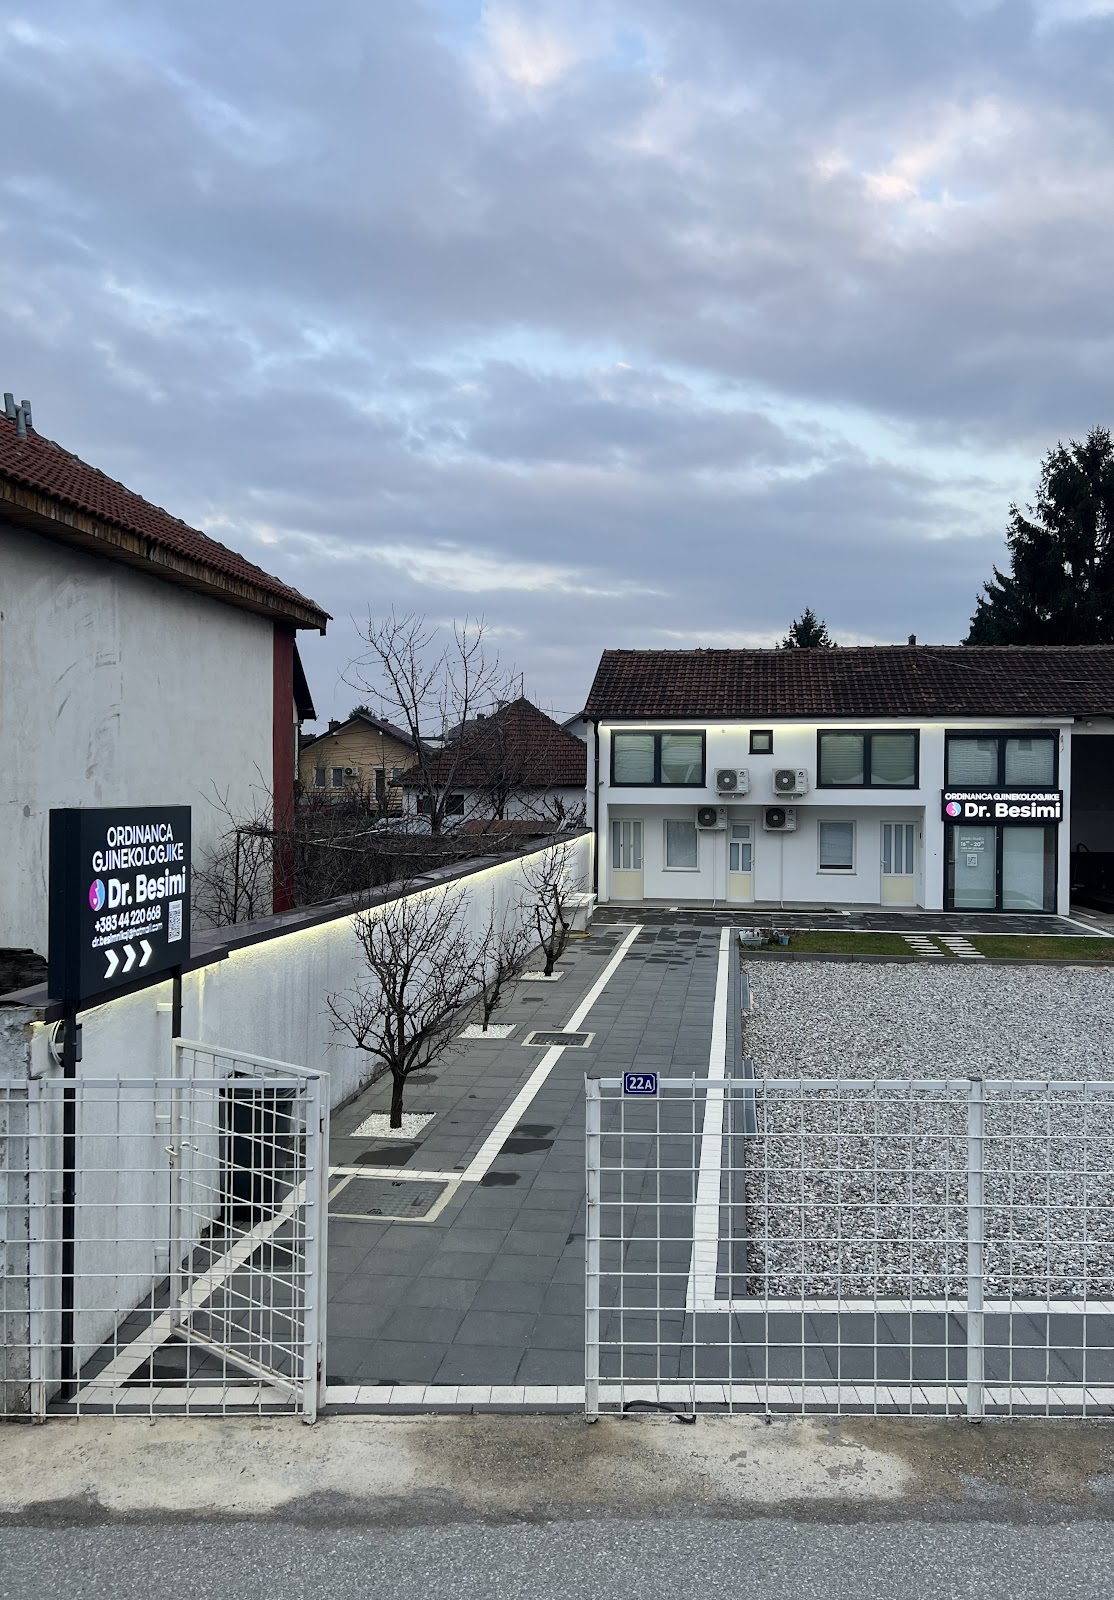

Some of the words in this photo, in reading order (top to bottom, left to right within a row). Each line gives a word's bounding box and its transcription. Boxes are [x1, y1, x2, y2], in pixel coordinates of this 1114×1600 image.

[945, 793, 993, 801] ORDINANCA
[964, 802, 991, 818] Dr.
[995, 802, 1061, 818] Besimi
[107, 823, 173, 847] ORDINANCA
[92, 842, 184, 872] GJINEKOLOGJIKE
[107, 878, 133, 909] Dr.
[135, 865, 186, 903] Besimi
[94, 914, 117, 933] +383
[118, 911, 130, 928] 44
[130, 908, 146, 925] 220
[146, 904, 162, 922] 668
[630, 1077, 653, 1089] 22A
